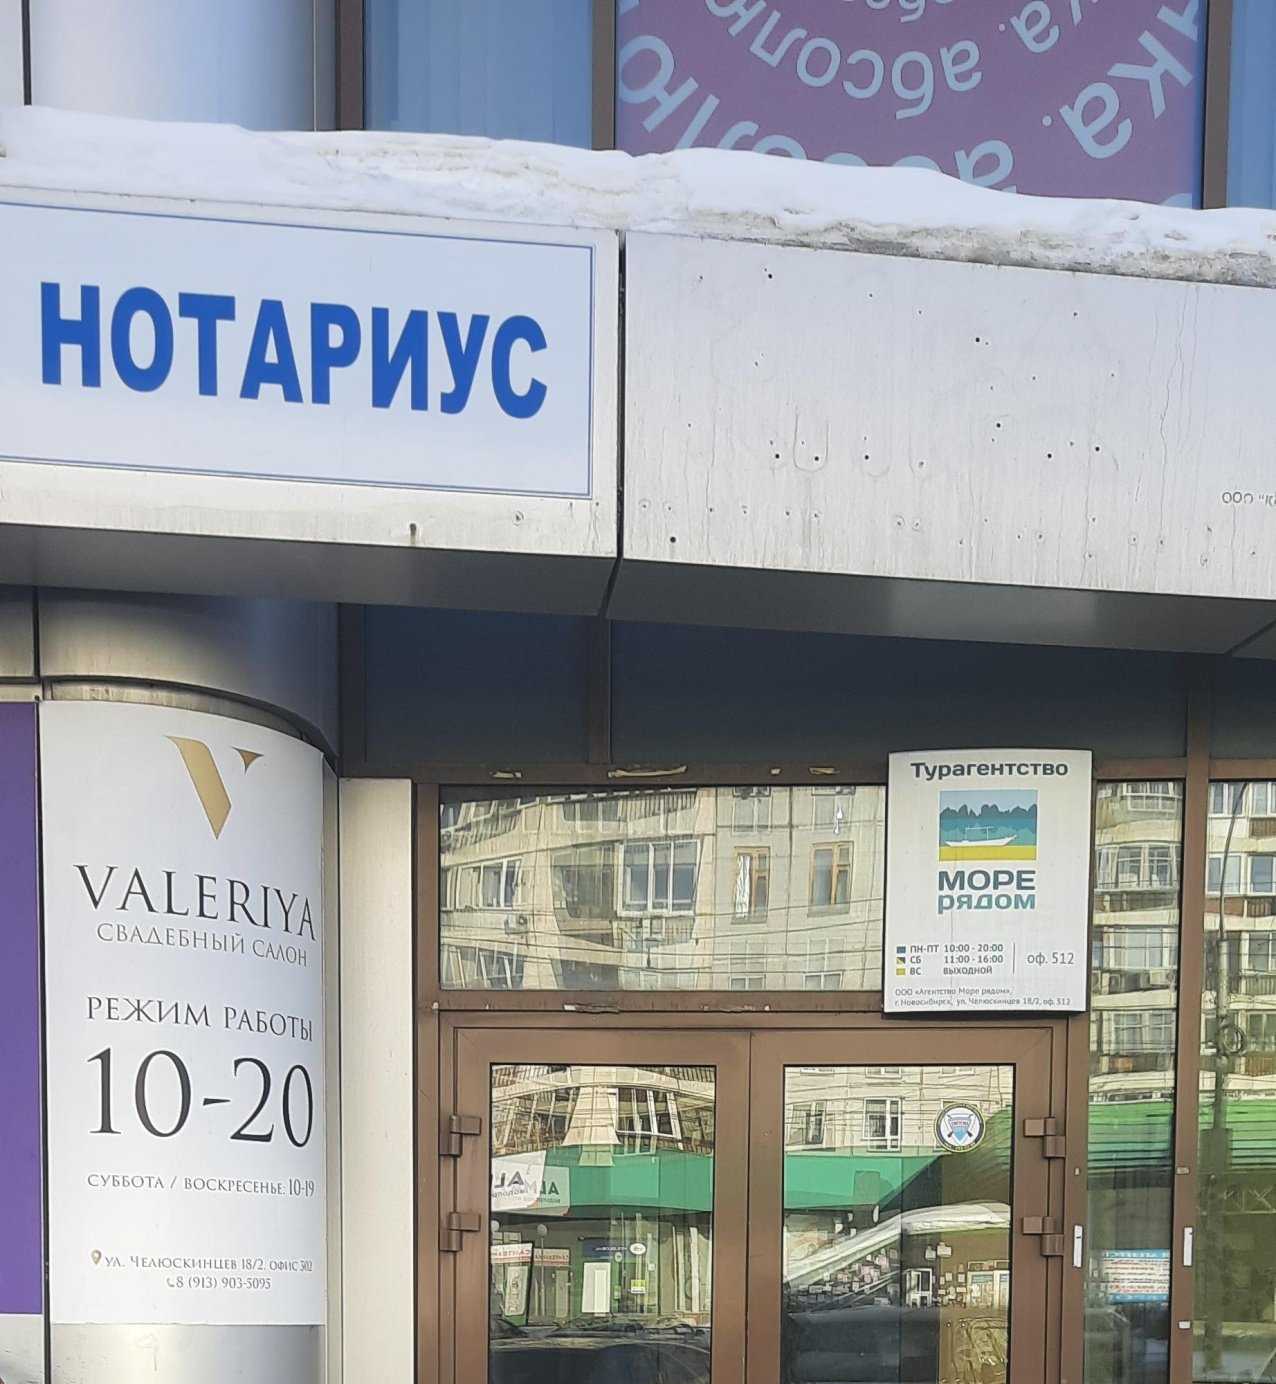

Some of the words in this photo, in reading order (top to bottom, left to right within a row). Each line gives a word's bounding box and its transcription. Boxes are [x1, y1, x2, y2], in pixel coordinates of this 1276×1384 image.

[40, 281, 548, 419] НОТАРИУС
[911, 762, 1068, 781] Турагентство
[938, 870, 1036, 892] МОРЕ
[74, 864, 316, 941] VALERIYA
[938, 893, 1036, 915] рядом
[97, 922, 245, 954] СВАДЕБНЫЙ
[252, 939, 307, 967] САЛОН
[910, 945, 939, 954] ПН-ПТ
[944, 944, 970, 953] 10:00
[978, 944, 1004, 953] 20:00
[944, 956, 970, 964] 11:00
[978, 955, 1004, 964] 16:00
[1027, 954, 1048, 966] оф.
[1052, 952, 1075, 965] 512
[943, 966, 993, 976] ВЫХОДНОЙ
[86, 996, 212, 1028] РЕЖИМ
[223, 1006, 313, 1042] РАБОТЫ
[86, 1047, 313, 1148] 10-20
[87, 1174, 164, 1189] СУББОТА
[289, 1178, 315, 1197] 10-19
[130, 1256, 237, 1270] ЧЕЛЮСКИНЦЕВ
[269, 1260, 298, 1272] ОФИС
[176, 1276, 184, 1288] 8
[188, 1276, 218, 1288] (913)
